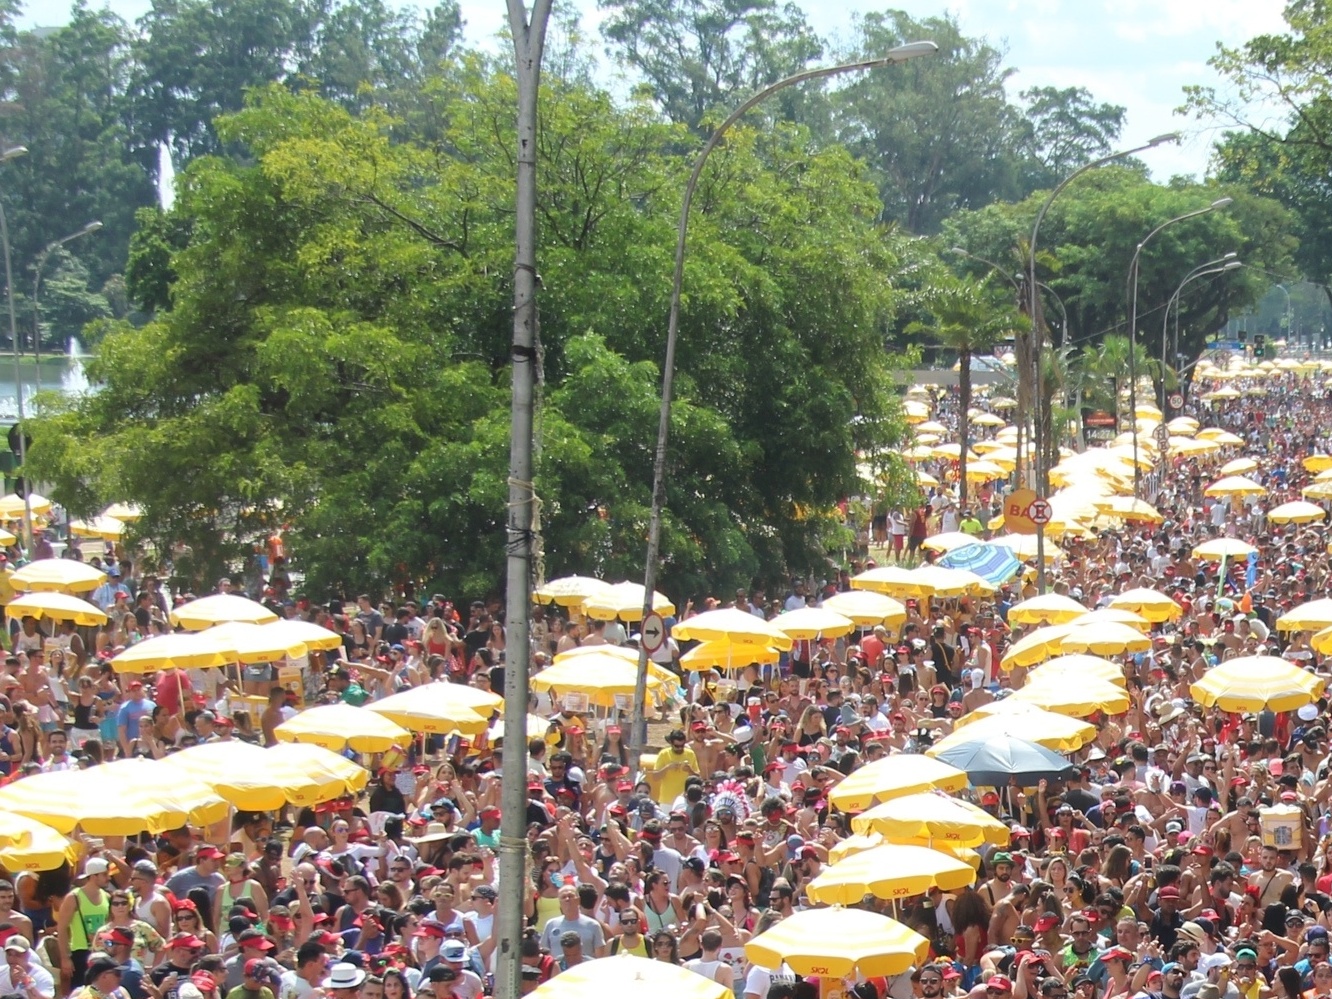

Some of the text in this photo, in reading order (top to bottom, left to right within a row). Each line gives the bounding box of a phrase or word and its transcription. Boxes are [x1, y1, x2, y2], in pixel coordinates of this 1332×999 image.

[1086, 429, 1110, 439] 14:27
[1010, 504, 1030, 518] BA
[811, 966, 830, 975] SKOL
